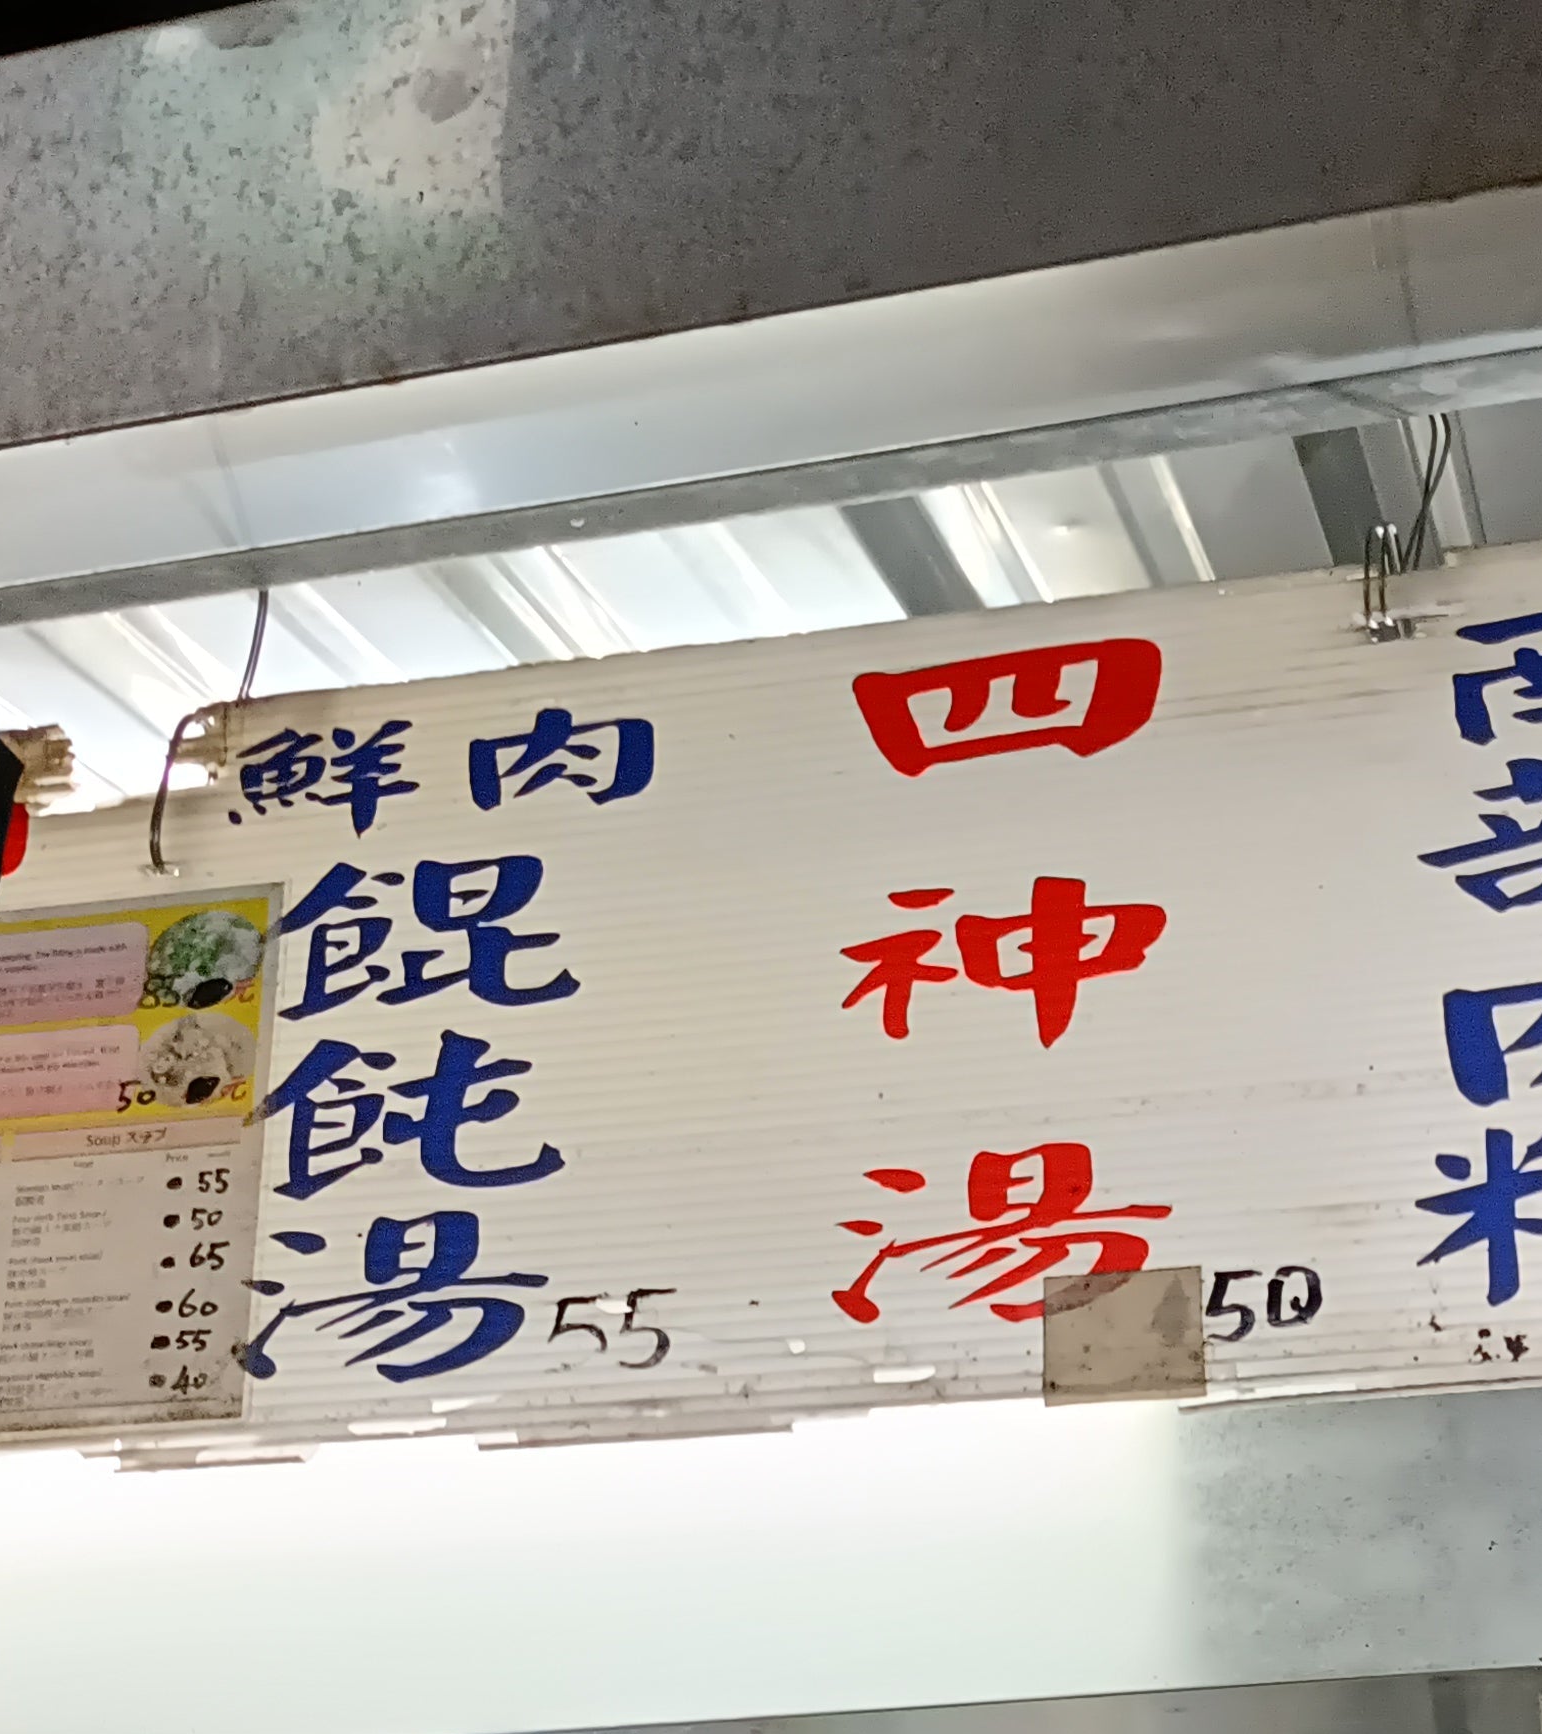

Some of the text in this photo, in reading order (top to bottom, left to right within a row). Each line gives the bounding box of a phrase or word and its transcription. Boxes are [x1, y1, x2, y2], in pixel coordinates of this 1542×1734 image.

[229, 707, 654, 836] 鮮肉
[831, 637, 1171, 1326] 四神湯
[116, 1079, 156, 1113] 50
[236, 855, 581, 1383] 餛飩湯
[86, 1133, 121, 1148] Soup
[197, 1168, 230, 1194] 55
[191, 1208, 223, 1230] 50
[189, 1241, 230, 1270] 65
[178, 1288, 219, 1318] 60
[1204, 1265, 1322, 1343] 50
[175, 1329, 212, 1351] 55
[547, 1289, 676, 1371] 55
